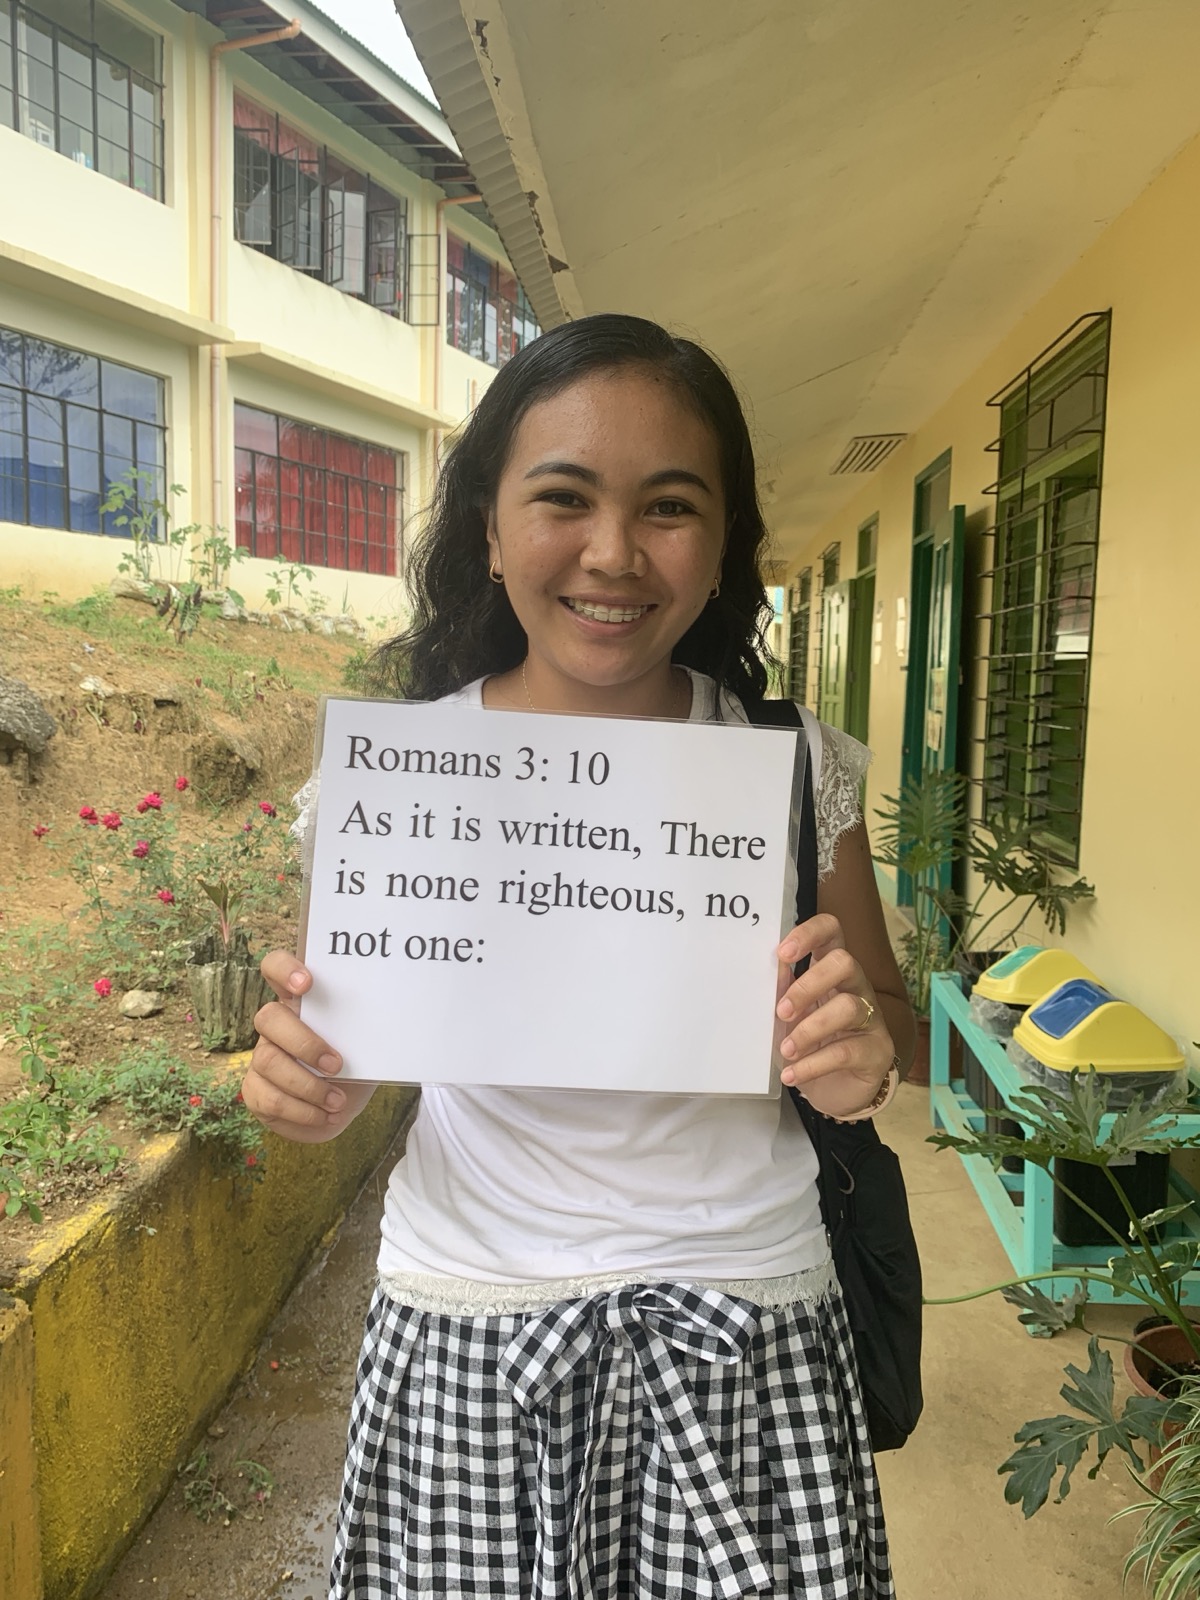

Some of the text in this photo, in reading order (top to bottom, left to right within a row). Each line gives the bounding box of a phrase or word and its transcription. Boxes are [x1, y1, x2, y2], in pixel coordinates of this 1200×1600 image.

[345, 735, 610, 786] Romans 3: 10
[338, 800, 766, 861] As it is written, There
[334, 858, 760, 926] is none righteous, no,
[329, 927, 485, 964] not one:
